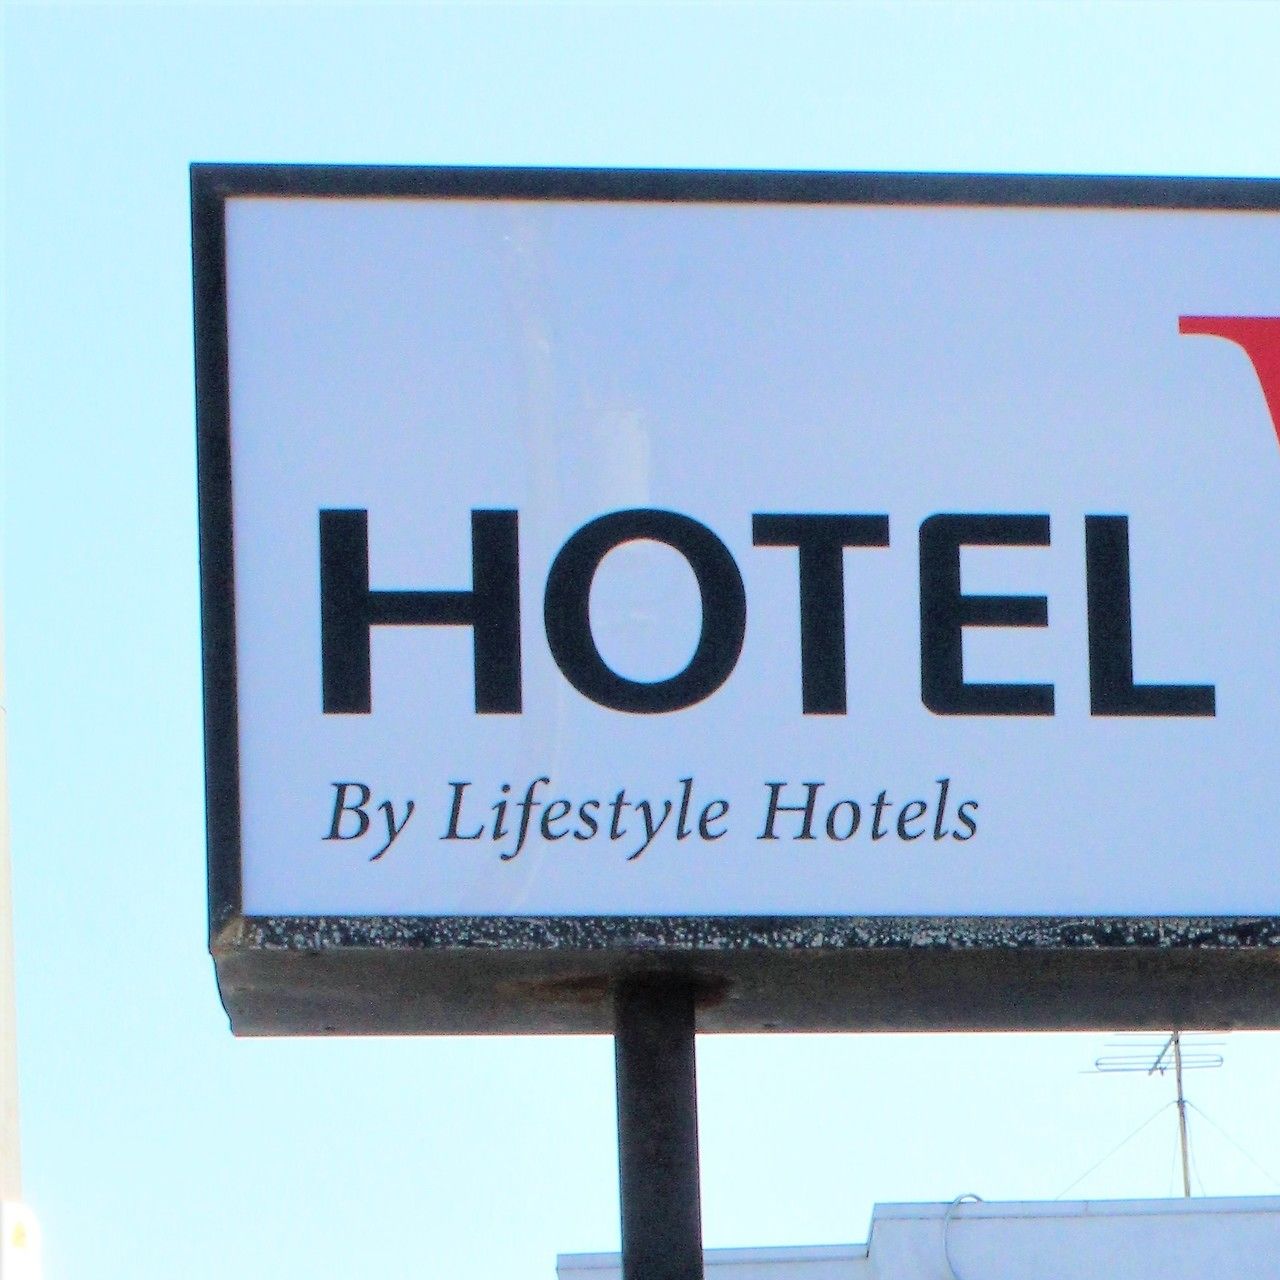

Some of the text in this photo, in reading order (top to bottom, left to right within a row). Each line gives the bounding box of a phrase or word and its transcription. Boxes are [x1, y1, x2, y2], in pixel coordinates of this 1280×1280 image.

[320, 509, 1215, 717] HOTEL
[323, 778, 978, 861] By Lifestyle Hotels
